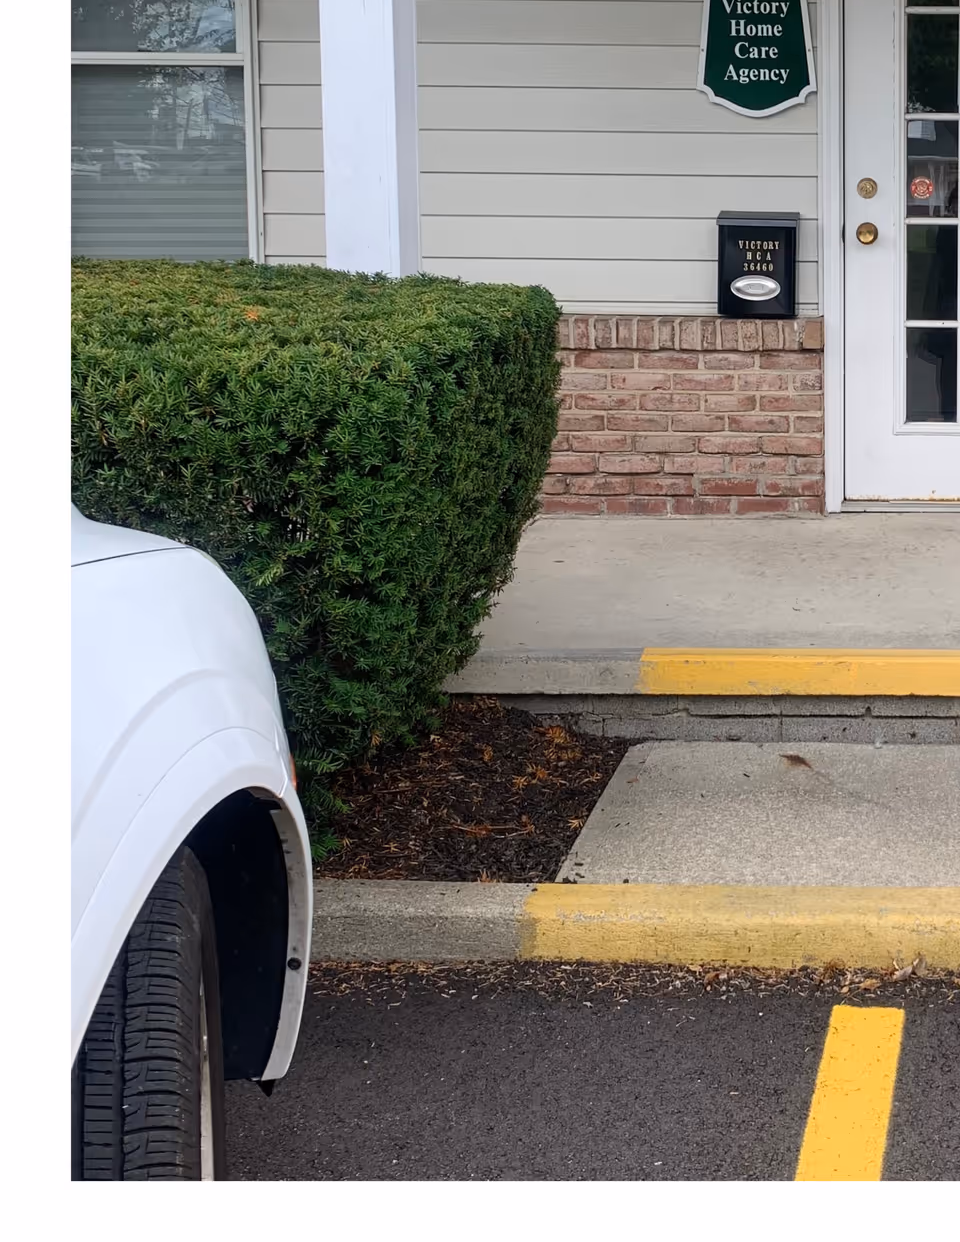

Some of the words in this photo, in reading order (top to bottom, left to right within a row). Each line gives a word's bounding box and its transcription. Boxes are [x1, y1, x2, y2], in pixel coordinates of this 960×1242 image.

[730, 19, 783, 38] Home
[734, 41, 779, 59] Care
[723, 64, 790, 85] Agency
[738, 240, 780, 250] VICTORY
[743, 262, 774, 272] 36460
